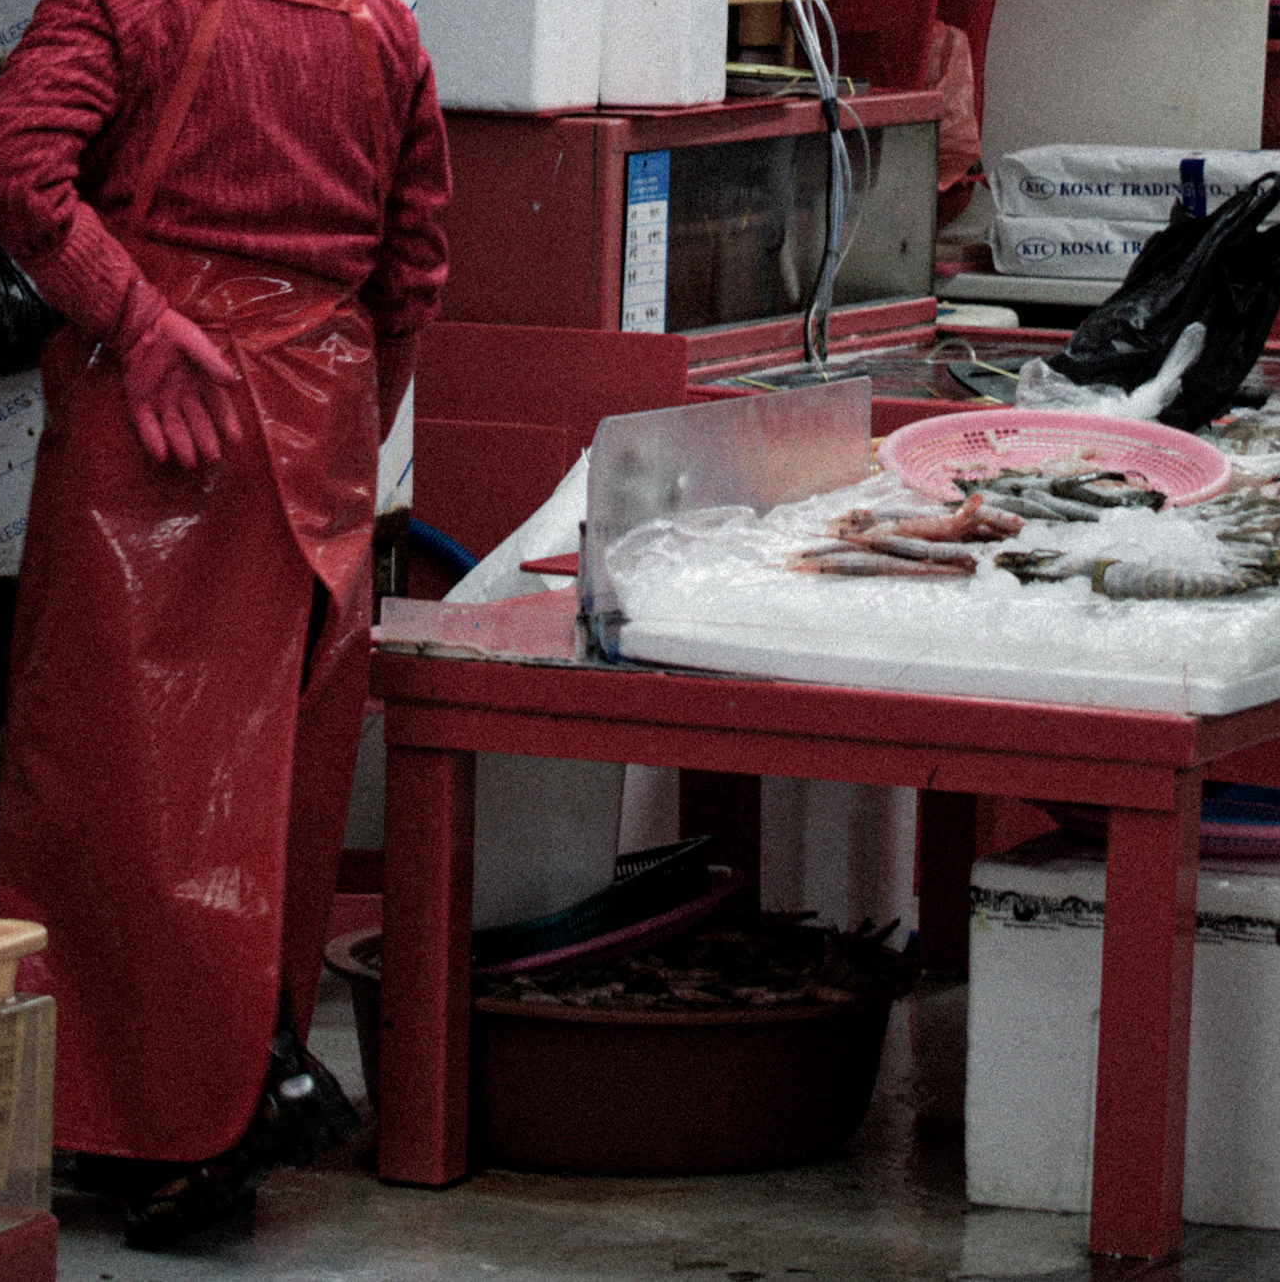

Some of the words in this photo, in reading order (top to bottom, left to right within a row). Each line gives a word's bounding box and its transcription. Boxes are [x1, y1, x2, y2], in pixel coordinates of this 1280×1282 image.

[1059, 181, 1117, 198] KOSAC
[1021, 243, 1051, 258] KTC
[1060, 240, 1117, 257] KOSAC
